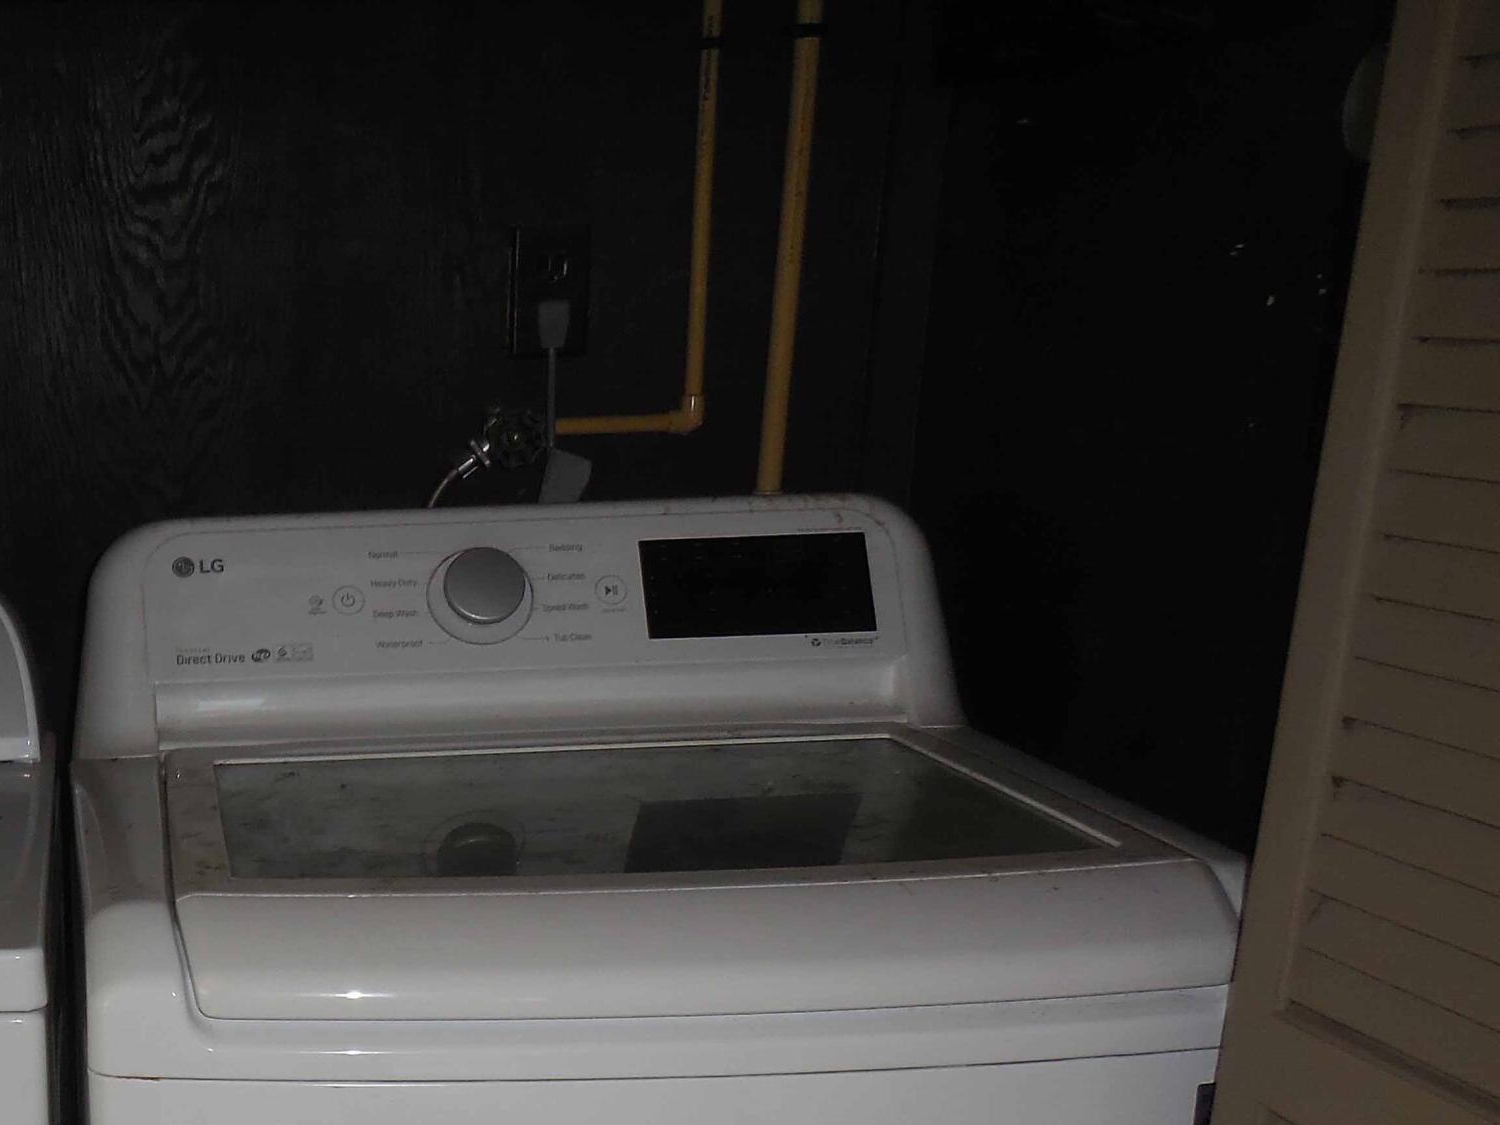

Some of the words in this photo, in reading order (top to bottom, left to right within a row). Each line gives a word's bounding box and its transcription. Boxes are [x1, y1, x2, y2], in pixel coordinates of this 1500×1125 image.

[198, 558, 225, 574] LG
[176, 652, 212, 666] Direct
[213, 652, 246, 665] Drive
